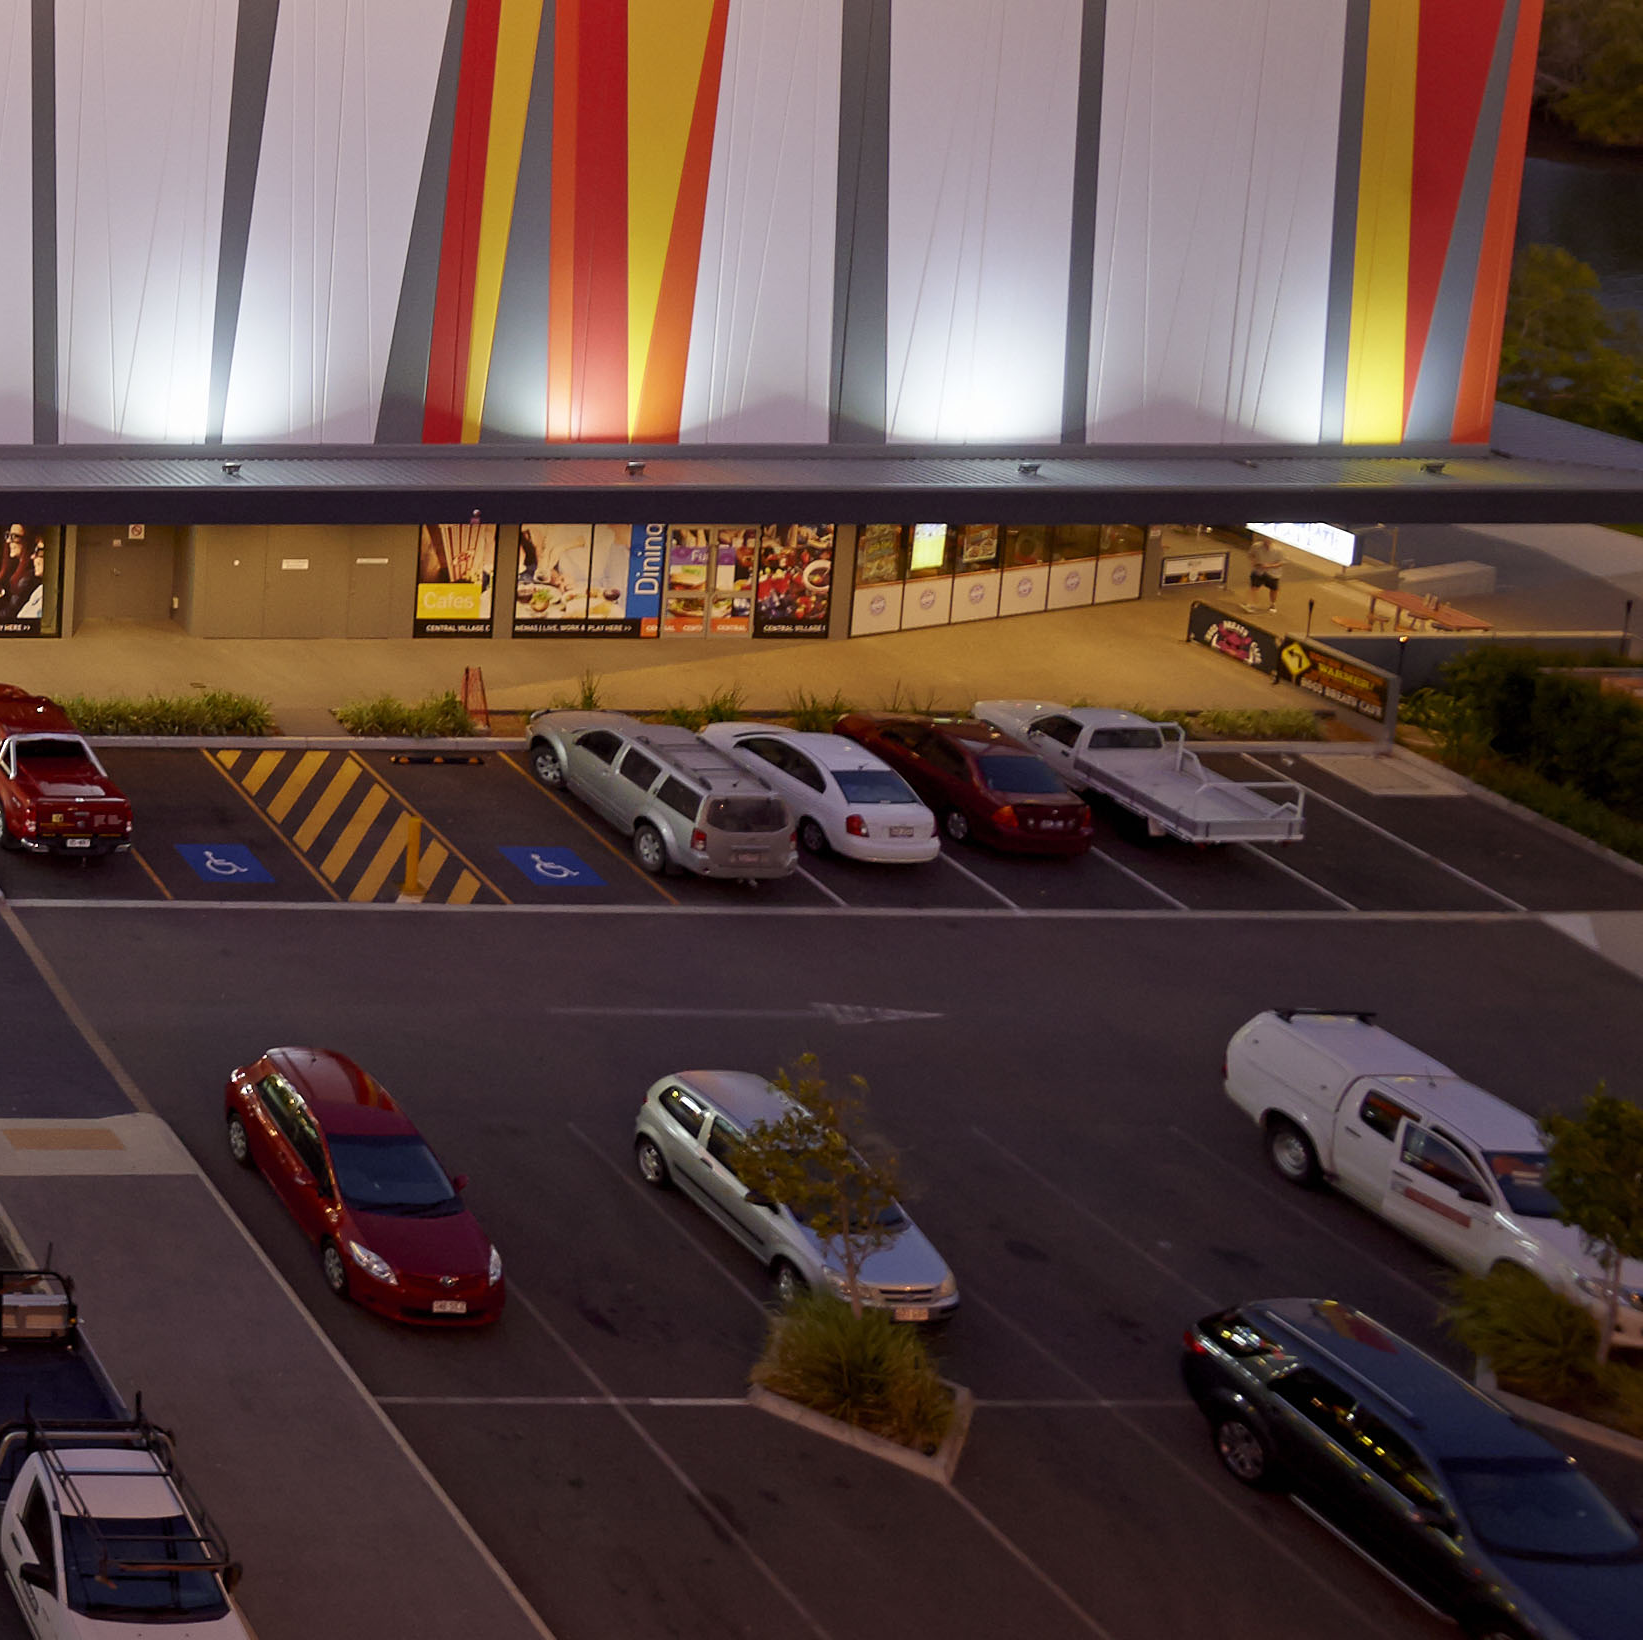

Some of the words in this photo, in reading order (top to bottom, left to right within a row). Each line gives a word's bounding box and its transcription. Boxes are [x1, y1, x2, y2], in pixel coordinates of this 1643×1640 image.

[691, 550, 708, 561] Fu
[423, 591, 474, 610] Cafes
[426, 624, 457, 632] CENTRAL
[457, 624, 484, 632] VILLAGE
[587, 624, 605, 632] PLAY
[605, 624, 623, 632] HERE
